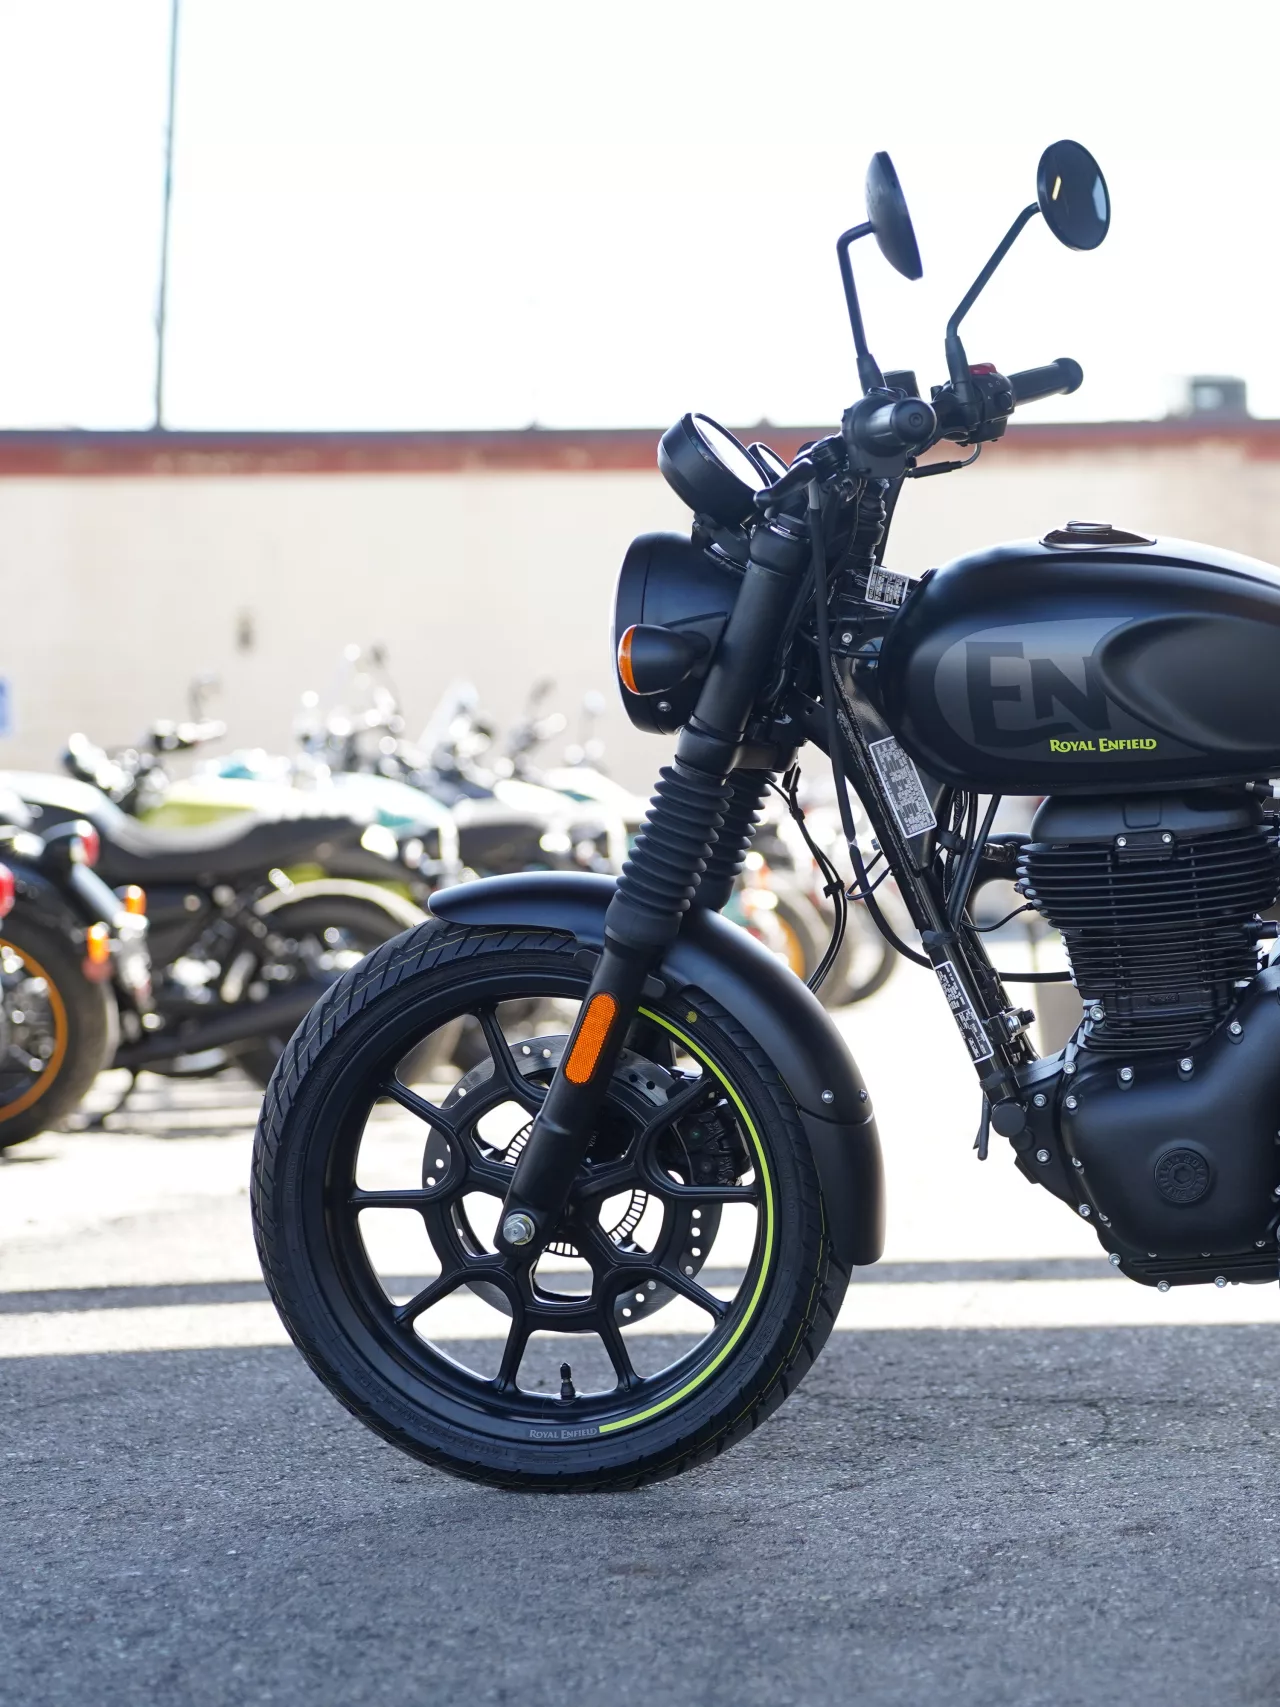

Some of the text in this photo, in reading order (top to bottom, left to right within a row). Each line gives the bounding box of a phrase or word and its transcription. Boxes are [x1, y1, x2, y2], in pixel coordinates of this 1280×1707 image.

[965, 641, 1112, 748] EN
[1050, 738, 1157, 753] ROYAL ENFIELD
[529, 1428, 598, 1440] ROYAL ENFIELD
